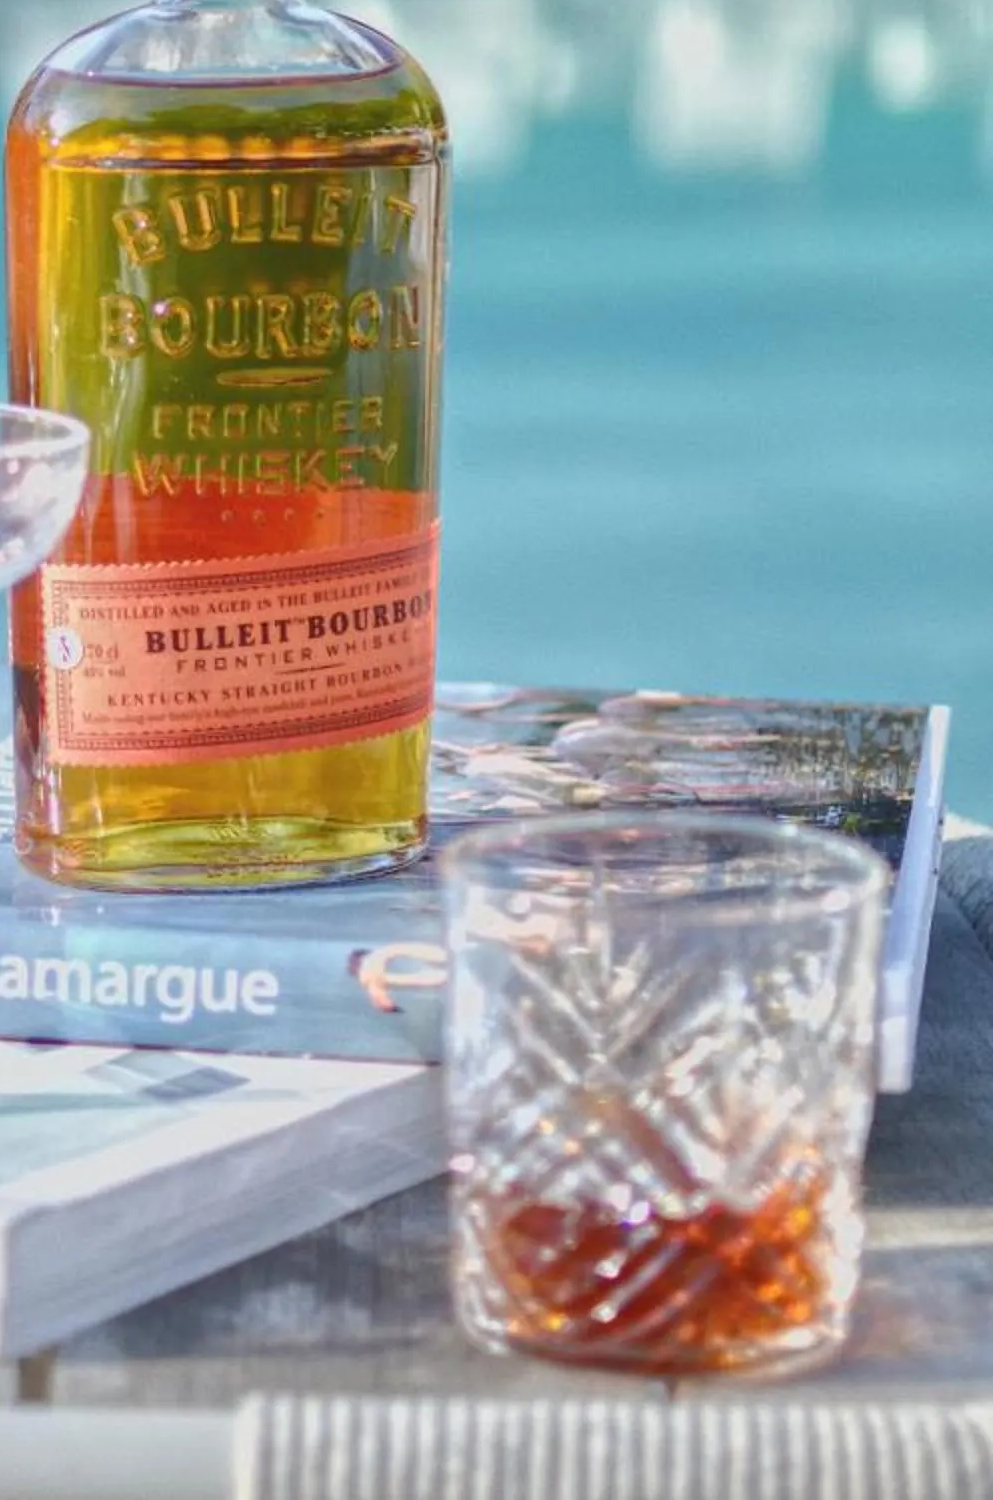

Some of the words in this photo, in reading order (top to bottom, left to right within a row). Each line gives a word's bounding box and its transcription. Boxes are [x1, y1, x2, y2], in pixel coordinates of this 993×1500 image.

[112, 183, 416, 264] BULLEIT
[100, 286, 420, 359] BOURBON
[153, 396, 383, 439] FRONTIER
[133, 444, 398, 496] WHISKEY
[81, 604, 164, 620] DISTILLED
[171, 603, 200, 617] AND
[209, 599, 251, 615] AGED
[278, 592, 308, 608] THE
[313, 581, 371, 603] BULLEIT
[145, 618, 291, 653] BULLEIT
[176, 647, 313, 674] FRONTIER
[326, 629, 412, 657] WHISKE
[107, 689, 210, 707] KENTUCKY
[222, 677, 316, 700] STRAIGHT
[326, 663, 403, 689] BOURBON
